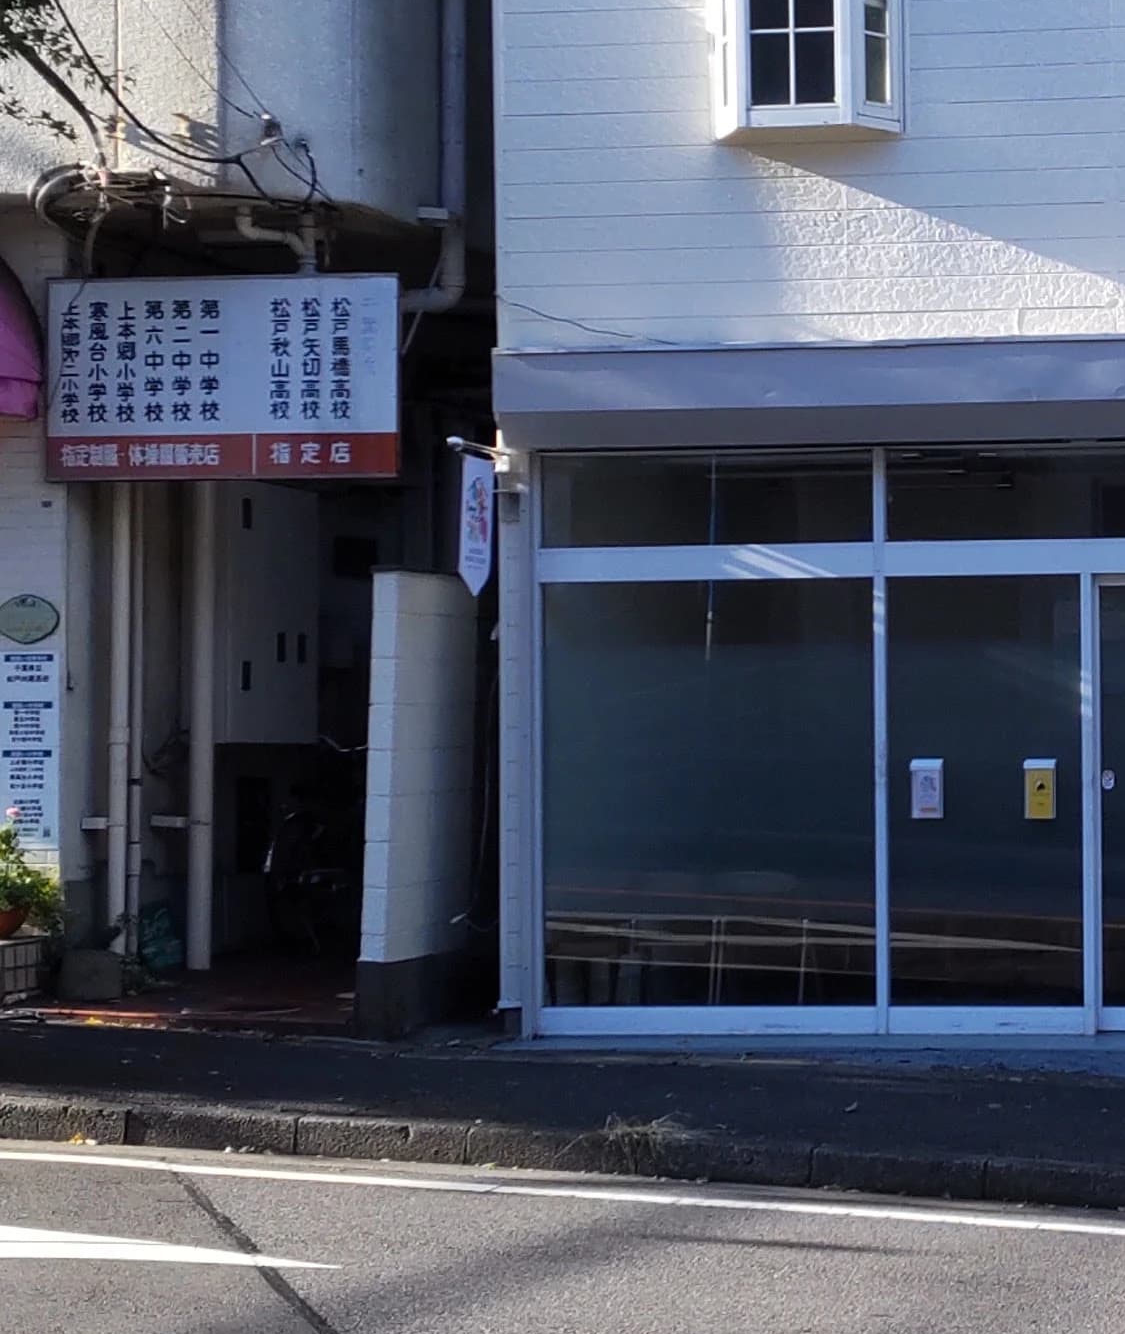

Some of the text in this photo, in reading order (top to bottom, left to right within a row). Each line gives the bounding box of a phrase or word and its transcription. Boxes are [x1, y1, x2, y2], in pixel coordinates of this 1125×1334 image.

[87, 302, 108, 423] 寒風台小学校
[116, 301, 137, 423] 上本郷小学校
[144, 300, 165, 422] 第六中学校
[172, 300, 192, 422] 第二中学校
[200, 299, 220, 422] 第一中学校
[269, 298, 291, 420] 松戸秋山高校
[300, 298, 321, 420] 松戸矢切高校
[329, 297, 351, 420] 松戸馬橋高校
[269, 441, 352, 465] 指定店
